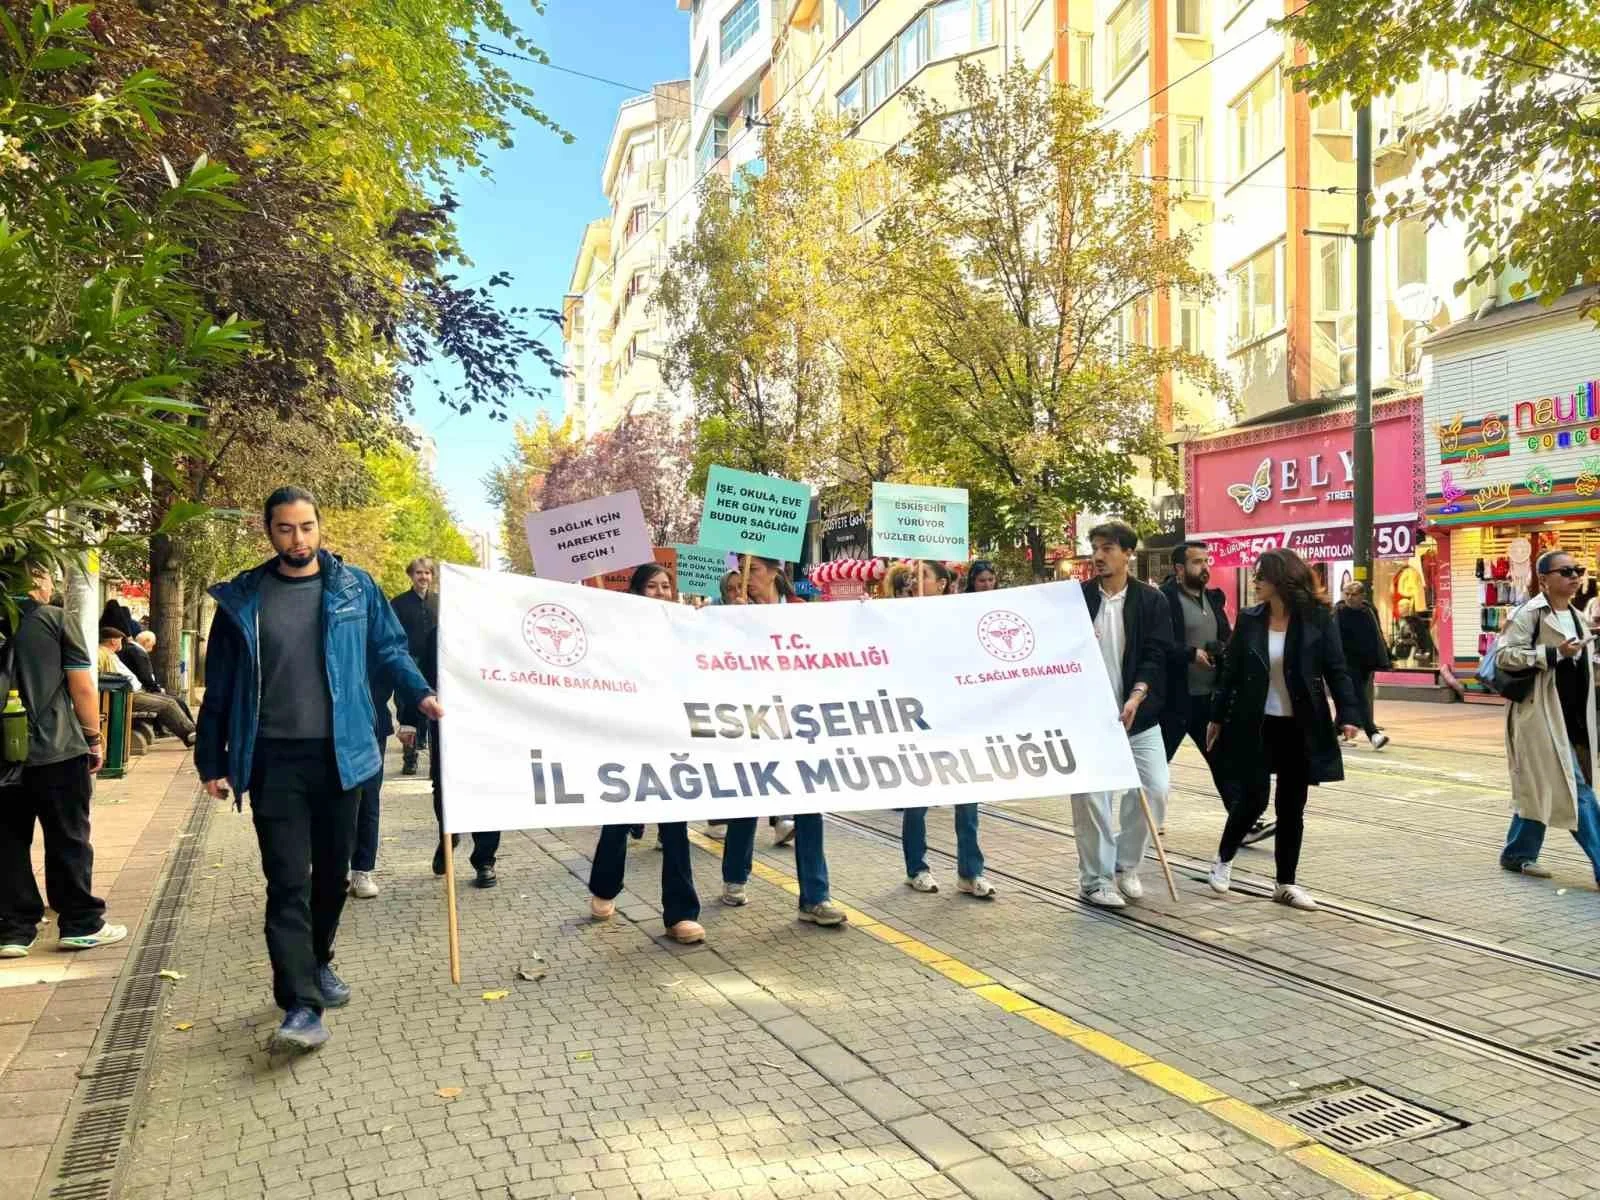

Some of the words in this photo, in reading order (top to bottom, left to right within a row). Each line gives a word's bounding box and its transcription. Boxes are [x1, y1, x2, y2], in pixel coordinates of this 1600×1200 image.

[716, 482, 737, 496] İŞE,
[740, 487, 778, 504] OKULA,
[782, 496, 802, 508] EVE
[717, 498, 739, 510] HER
[742, 502, 765, 514] GÜN
[895, 501, 947, 513] ESKİŞEHİR
[549, 518, 594, 536] SAĞLIK
[596, 511, 621, 525] İÇİN
[709, 511, 748, 526] BUDUR
[750, 517, 800, 534] SAĞLIĞIN
[557, 528, 621, 550] HAREKETE
[740, 530, 766, 543] ÖZÜ!
[877, 532, 916, 542] YÜZLER
[918, 534, 965, 545] GÜLÜYOR
[1302, 534, 1325, 544] ADET
[571, 547, 608, 563] GEÇİN
[769, 634, 811, 651] T.C.
[695, 651, 774, 671] SAĞLIK
[777, 646, 890, 671] BAKANLIĞI
[480, 668, 507, 681] T.C.
[510, 671, 560, 687] SAĞLIK
[563, 676, 638, 693] BAKANLIĞI
[954, 675, 978, 685] T.C.
[978, 669, 1020, 683] SAĞLIK
[1022, 661, 1083, 678] BAKANLIĞI
[683, 689, 932, 744] ESKİŞEHİR
[530, 749, 584, 805] İL
[598, 752, 792, 803] SAĞLIK
[796, 729, 1077, 796] MÜDÜRLÜĞÜ
